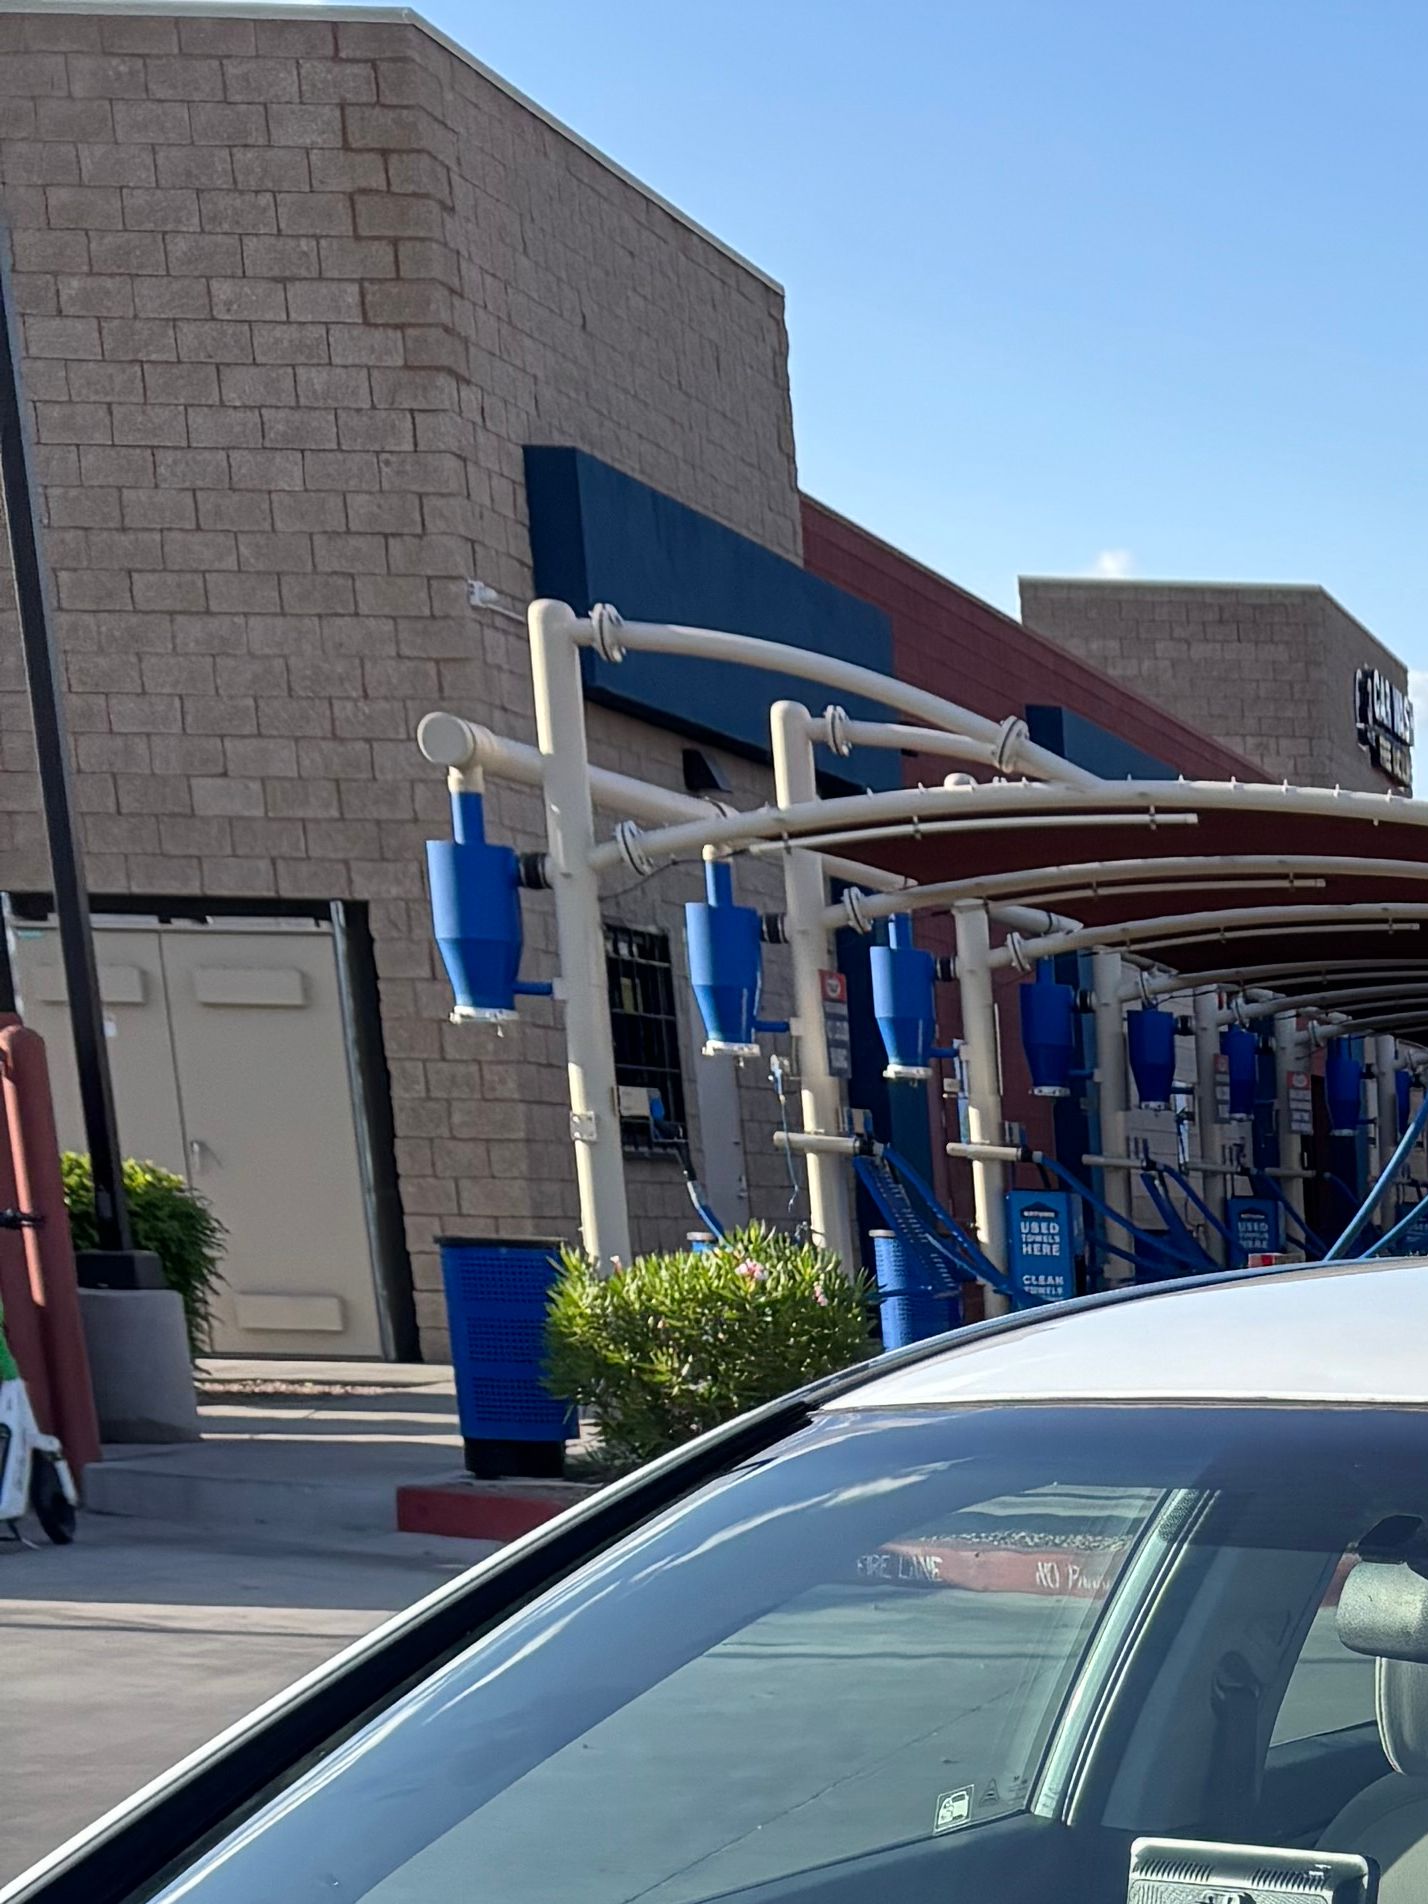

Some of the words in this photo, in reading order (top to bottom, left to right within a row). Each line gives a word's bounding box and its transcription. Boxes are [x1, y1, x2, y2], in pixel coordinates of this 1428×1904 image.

[1020, 1221, 1060, 1234] USED
[1022, 1244, 1060, 1256] HERE
[1022, 1275, 1065, 1286] CLEAN
[1036, 1561, 1060, 1590] NO
